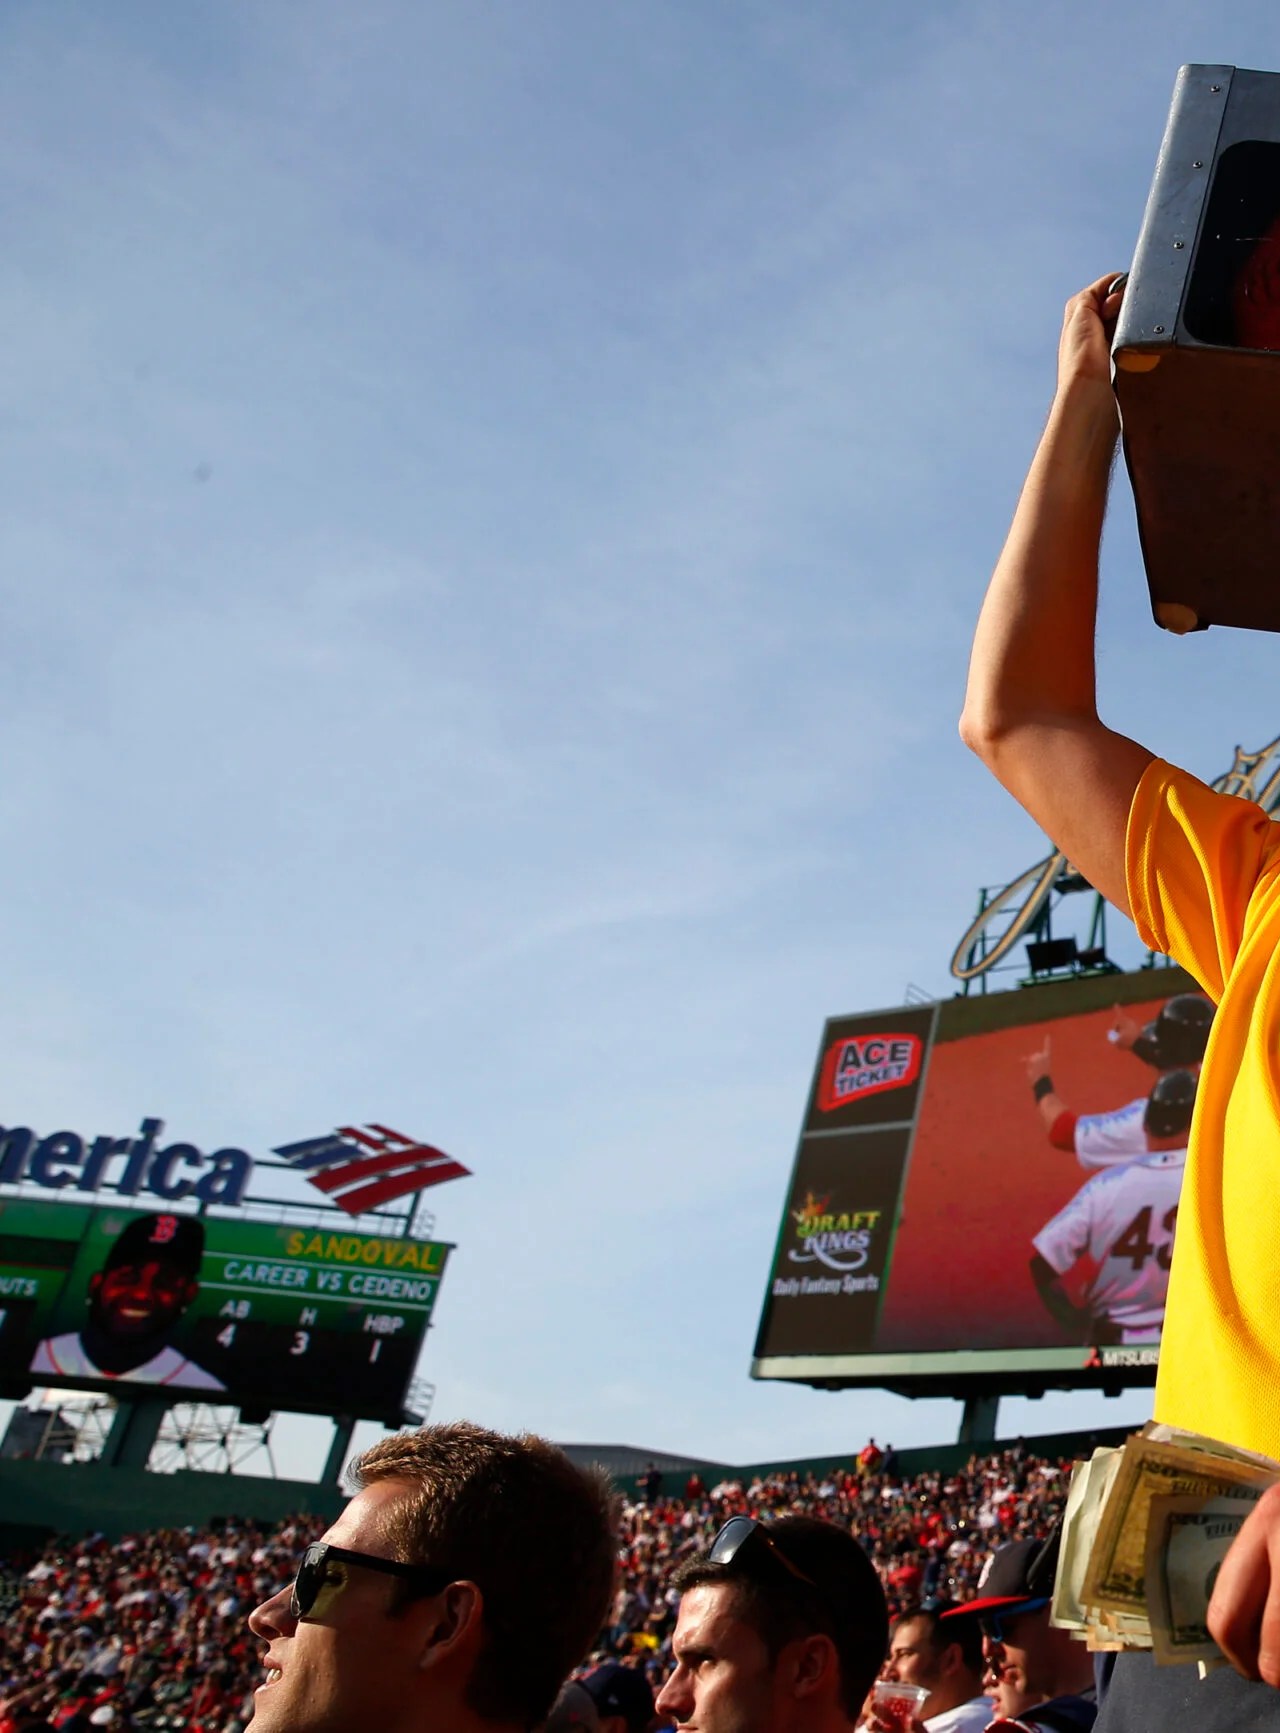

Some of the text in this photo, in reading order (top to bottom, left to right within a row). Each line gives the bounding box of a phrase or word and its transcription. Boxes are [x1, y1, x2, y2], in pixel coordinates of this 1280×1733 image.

[840, 1042, 911, 1073] ACE
[836, 1063, 906, 1094] TICKET
[796, 1210, 882, 1239] DRAFT
[286, 1232, 441, 1272] SANDOVAL
[788, 1229, 871, 1261] KINGS
[223, 1261, 432, 1301] CAREER VS CEDENO
[219, 1299, 405, 1335] AB H HBP
[216, 1323, 237, 1348] 4
[290, 1331, 310, 1356] 3
